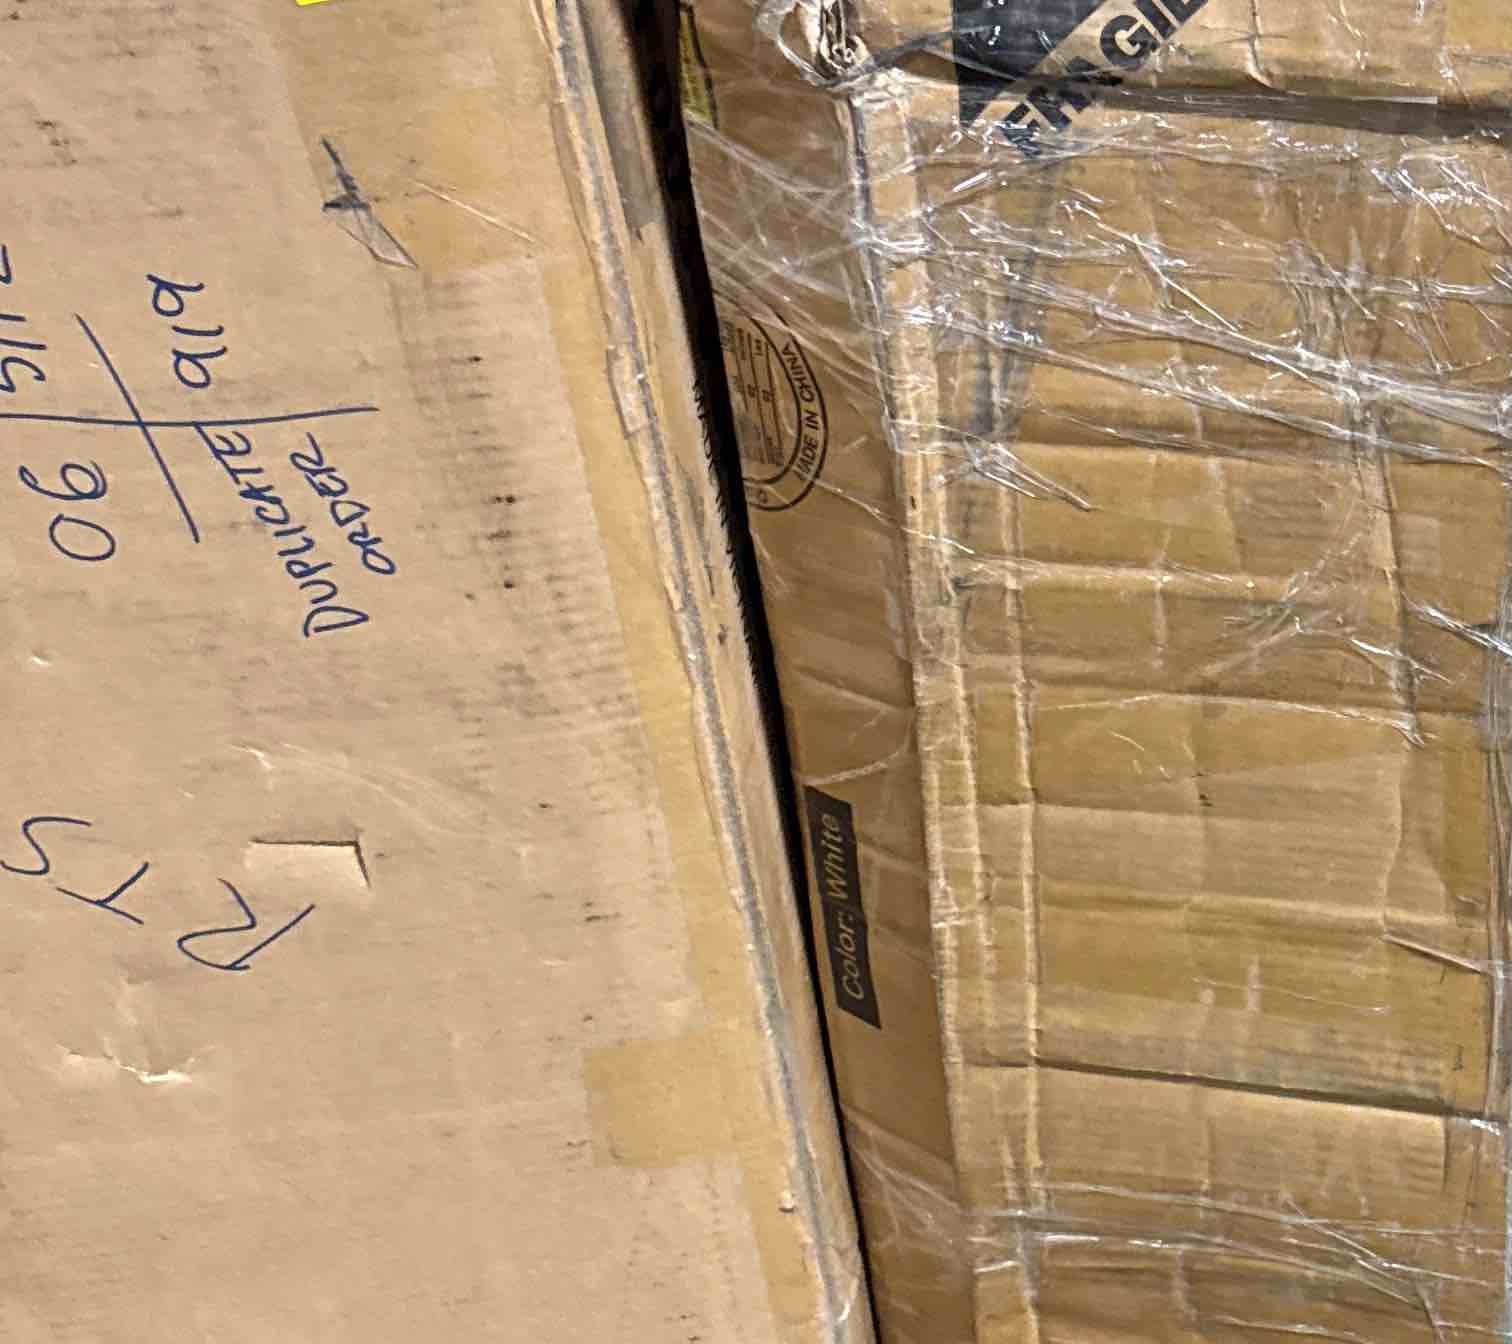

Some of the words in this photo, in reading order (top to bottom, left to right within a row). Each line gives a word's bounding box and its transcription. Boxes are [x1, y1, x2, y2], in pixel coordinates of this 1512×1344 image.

[781, 342, 815, 403] CHINA
[198, 425, 370, 638] DUPLICATE
[290, 432, 398, 576] ORDER
[820, 812, 848, 900] White
